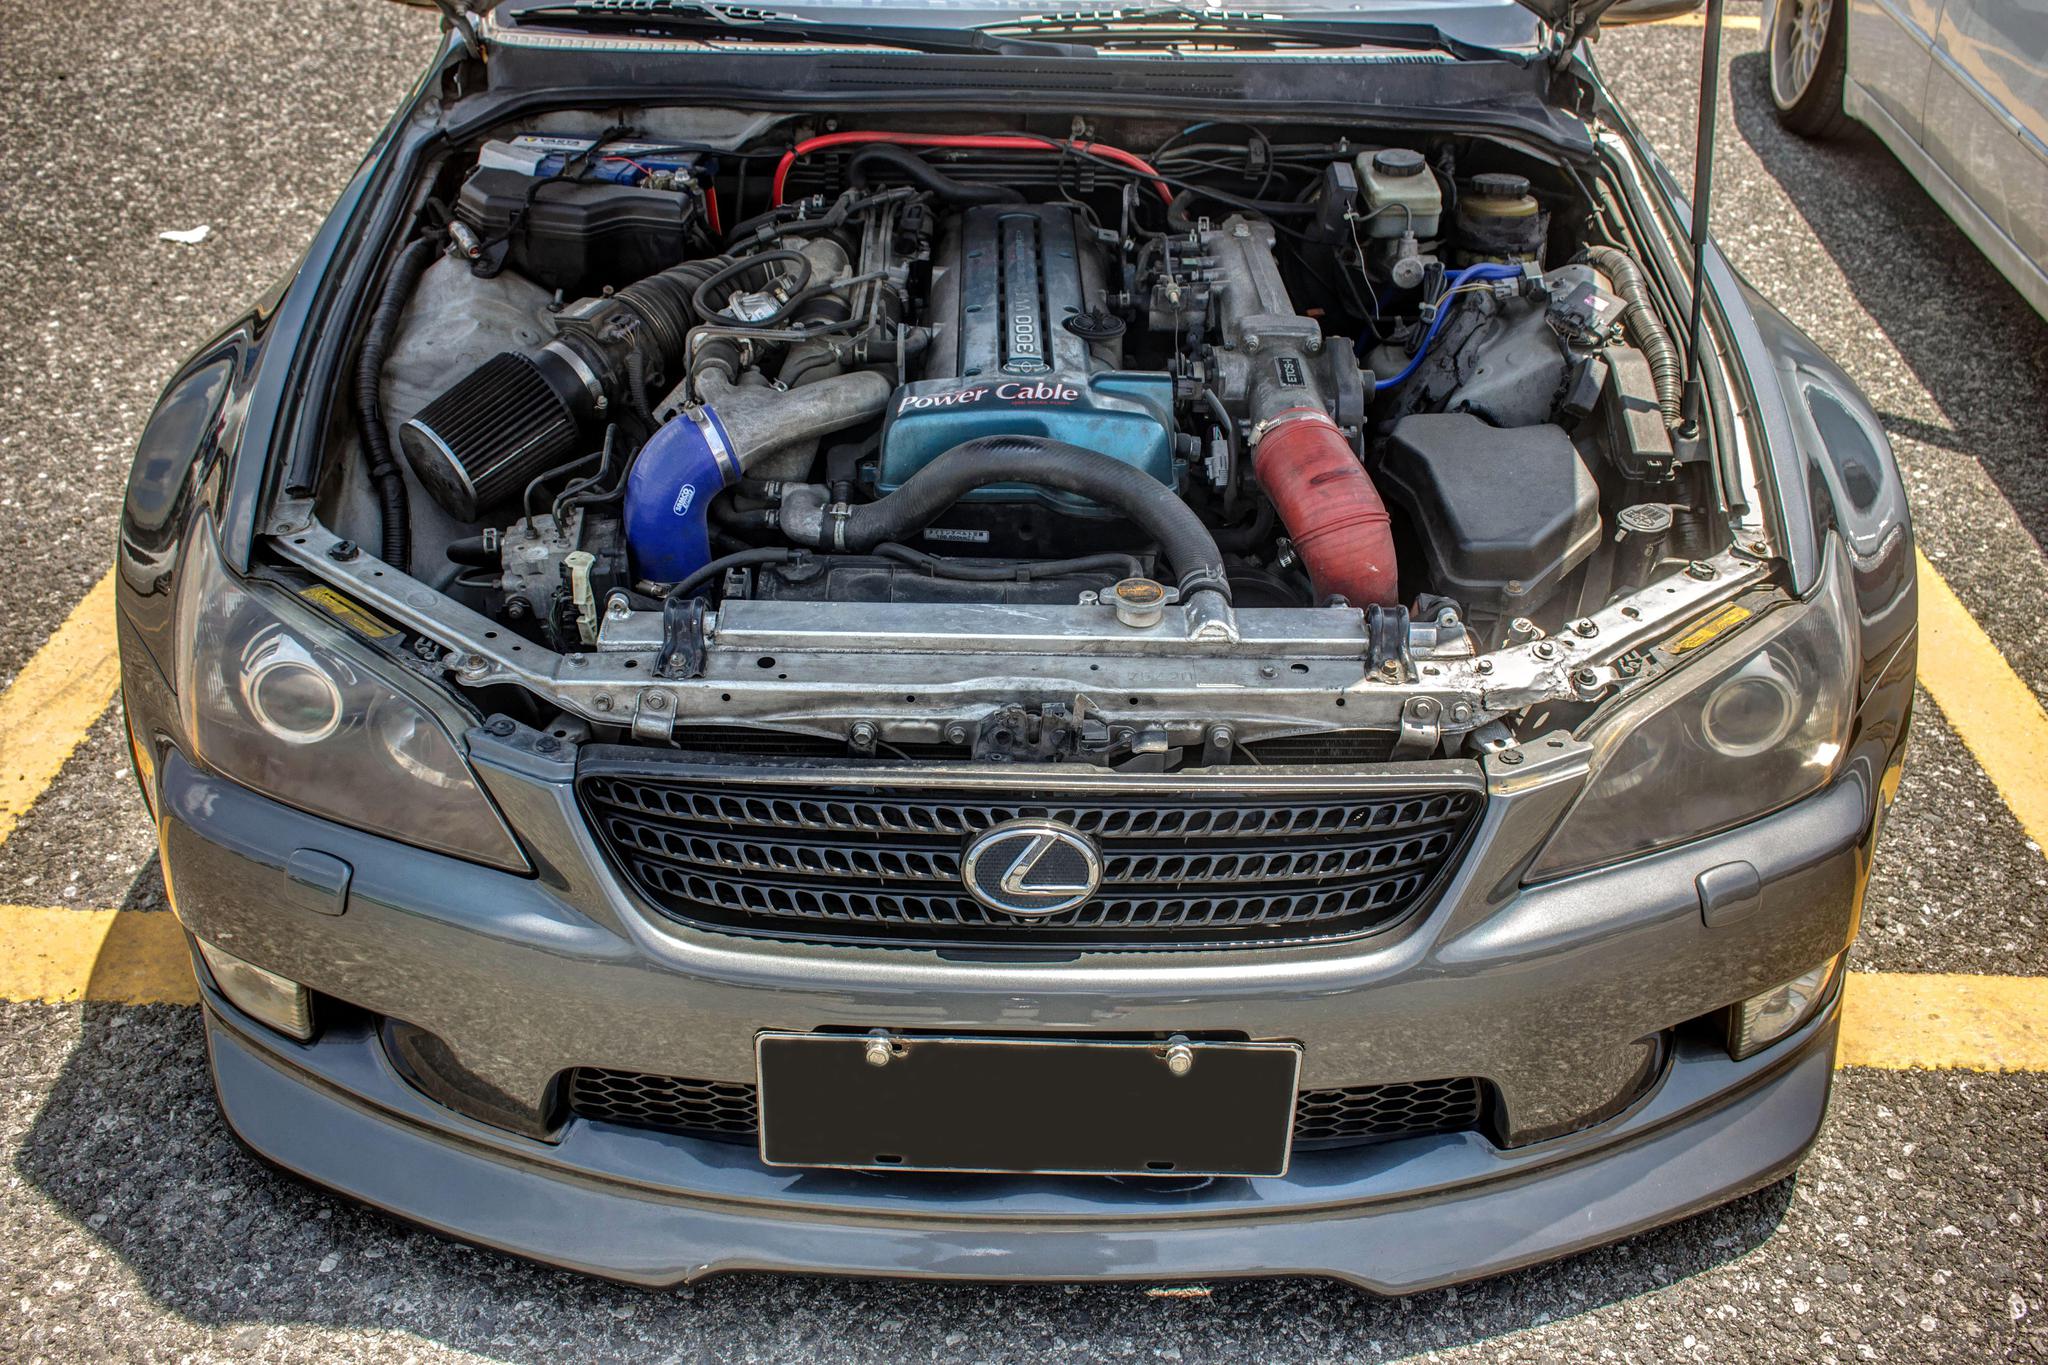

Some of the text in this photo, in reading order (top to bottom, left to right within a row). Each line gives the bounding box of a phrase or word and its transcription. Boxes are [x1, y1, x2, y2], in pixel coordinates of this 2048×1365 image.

[1015, 315, 1034, 353] 3000
[897, 382, 1079, 416] Power Cable
